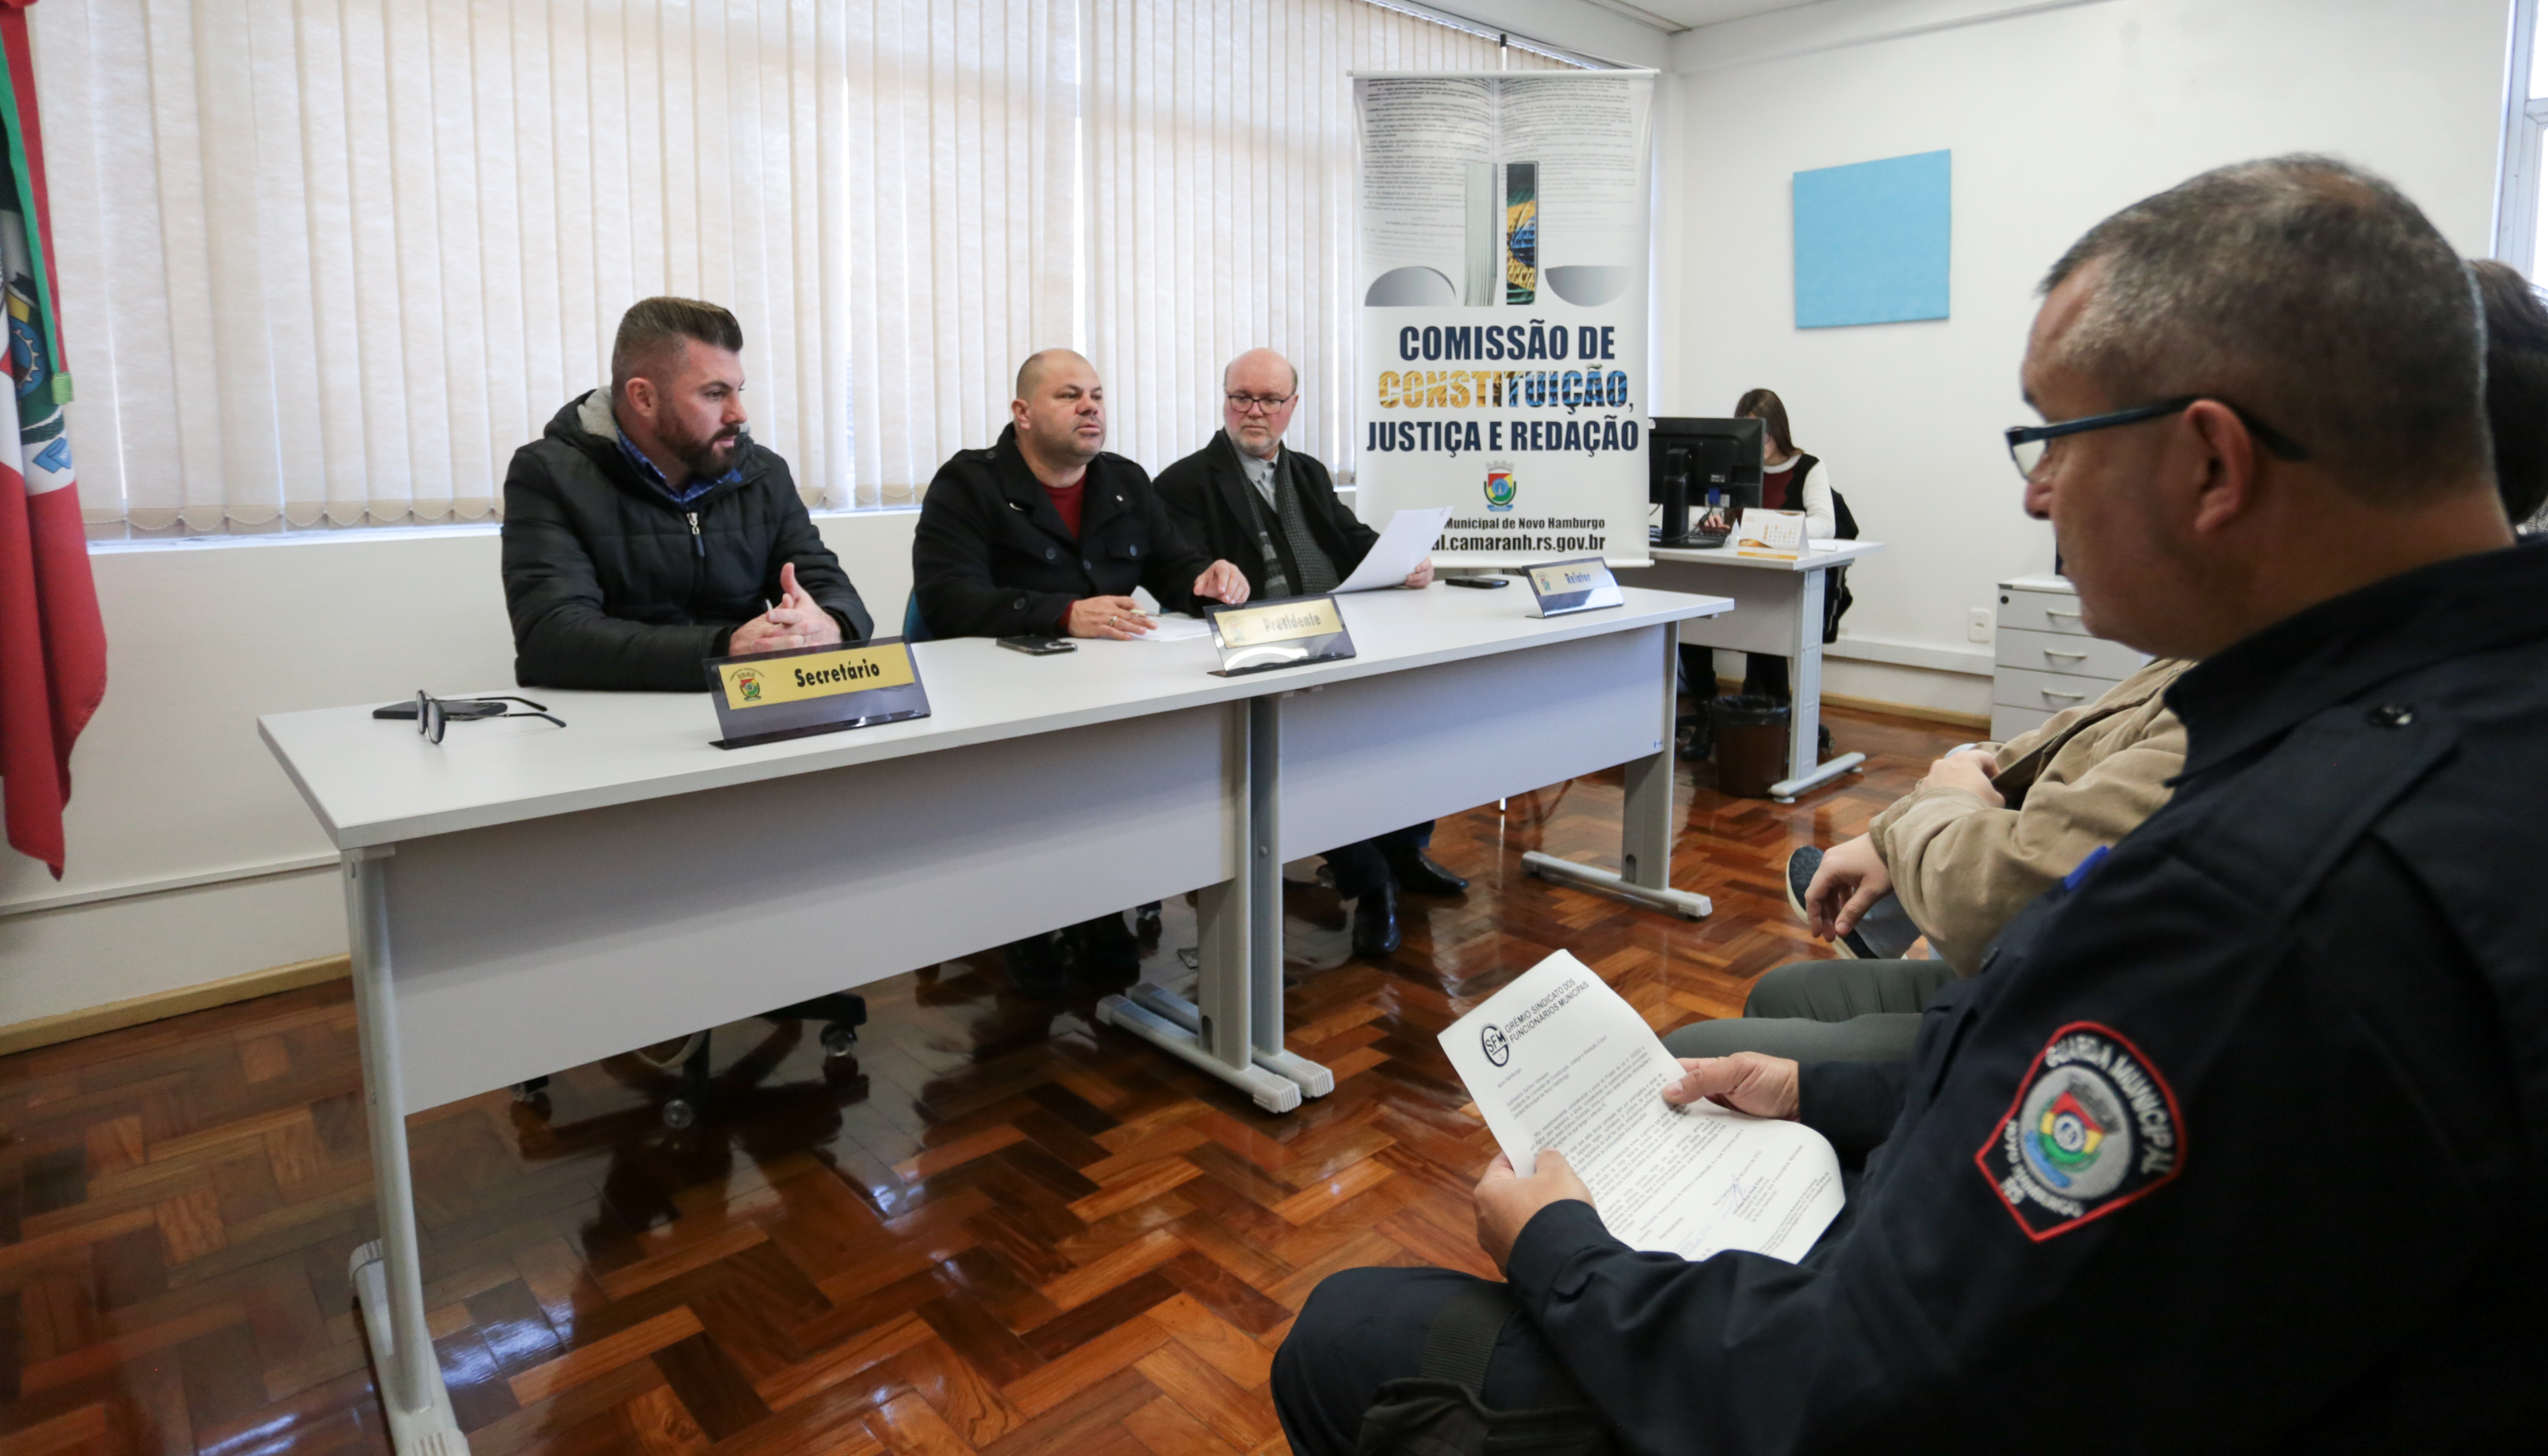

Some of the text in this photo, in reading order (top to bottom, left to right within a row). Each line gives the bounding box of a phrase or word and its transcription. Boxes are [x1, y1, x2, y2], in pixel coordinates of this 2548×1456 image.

[1399, 319, 1615, 360] COMISSÃO DE
[1378, 363, 1635, 414] CONSTITUIÇÃO,
[1366, 415, 1639, 457] JUSTIÇA E REDAÇÃO
[1502, 518, 1516, 529] de
[1519, 518, 1545, 529] Novo
[1548, 518, 1605, 530] Hamburgo
[1565, 571, 1591, 584] Relator
[1262, 613, 1321, 632] Presidente
[794, 658, 881, 688] Secretário
[1505, 978, 1576, 1033] GRÊMIO SINDICATO DOS
[1510, 981, 1589, 1043] FUNCIONÁRIOS MUNICIPAIS
